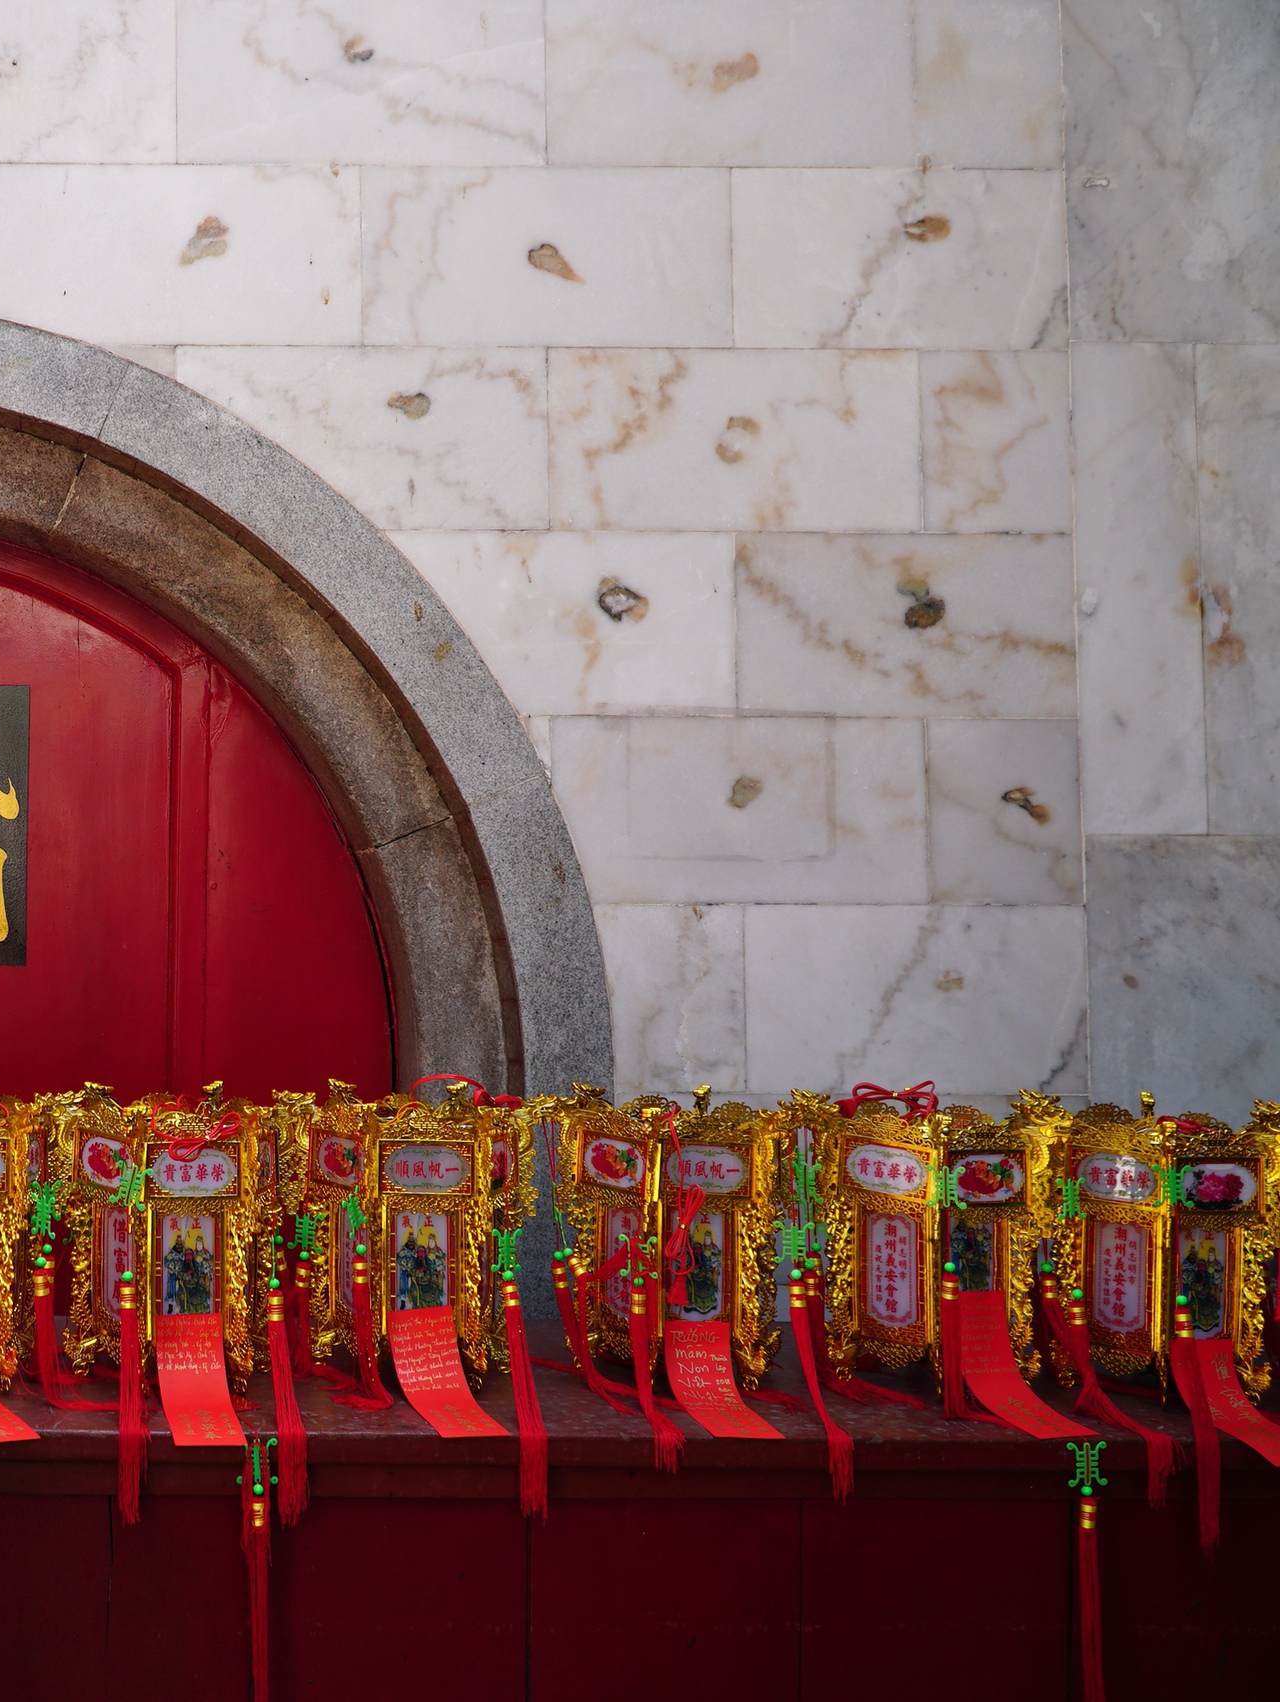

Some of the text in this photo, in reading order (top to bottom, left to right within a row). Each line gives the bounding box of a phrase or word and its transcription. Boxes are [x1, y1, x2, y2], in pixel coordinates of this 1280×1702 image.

[884, 1223, 899, 1314] 潮州義安會館
[1111, 1227, 1127, 1319] 潮州義安會館
[677, 1361, 709, 1374] Non
